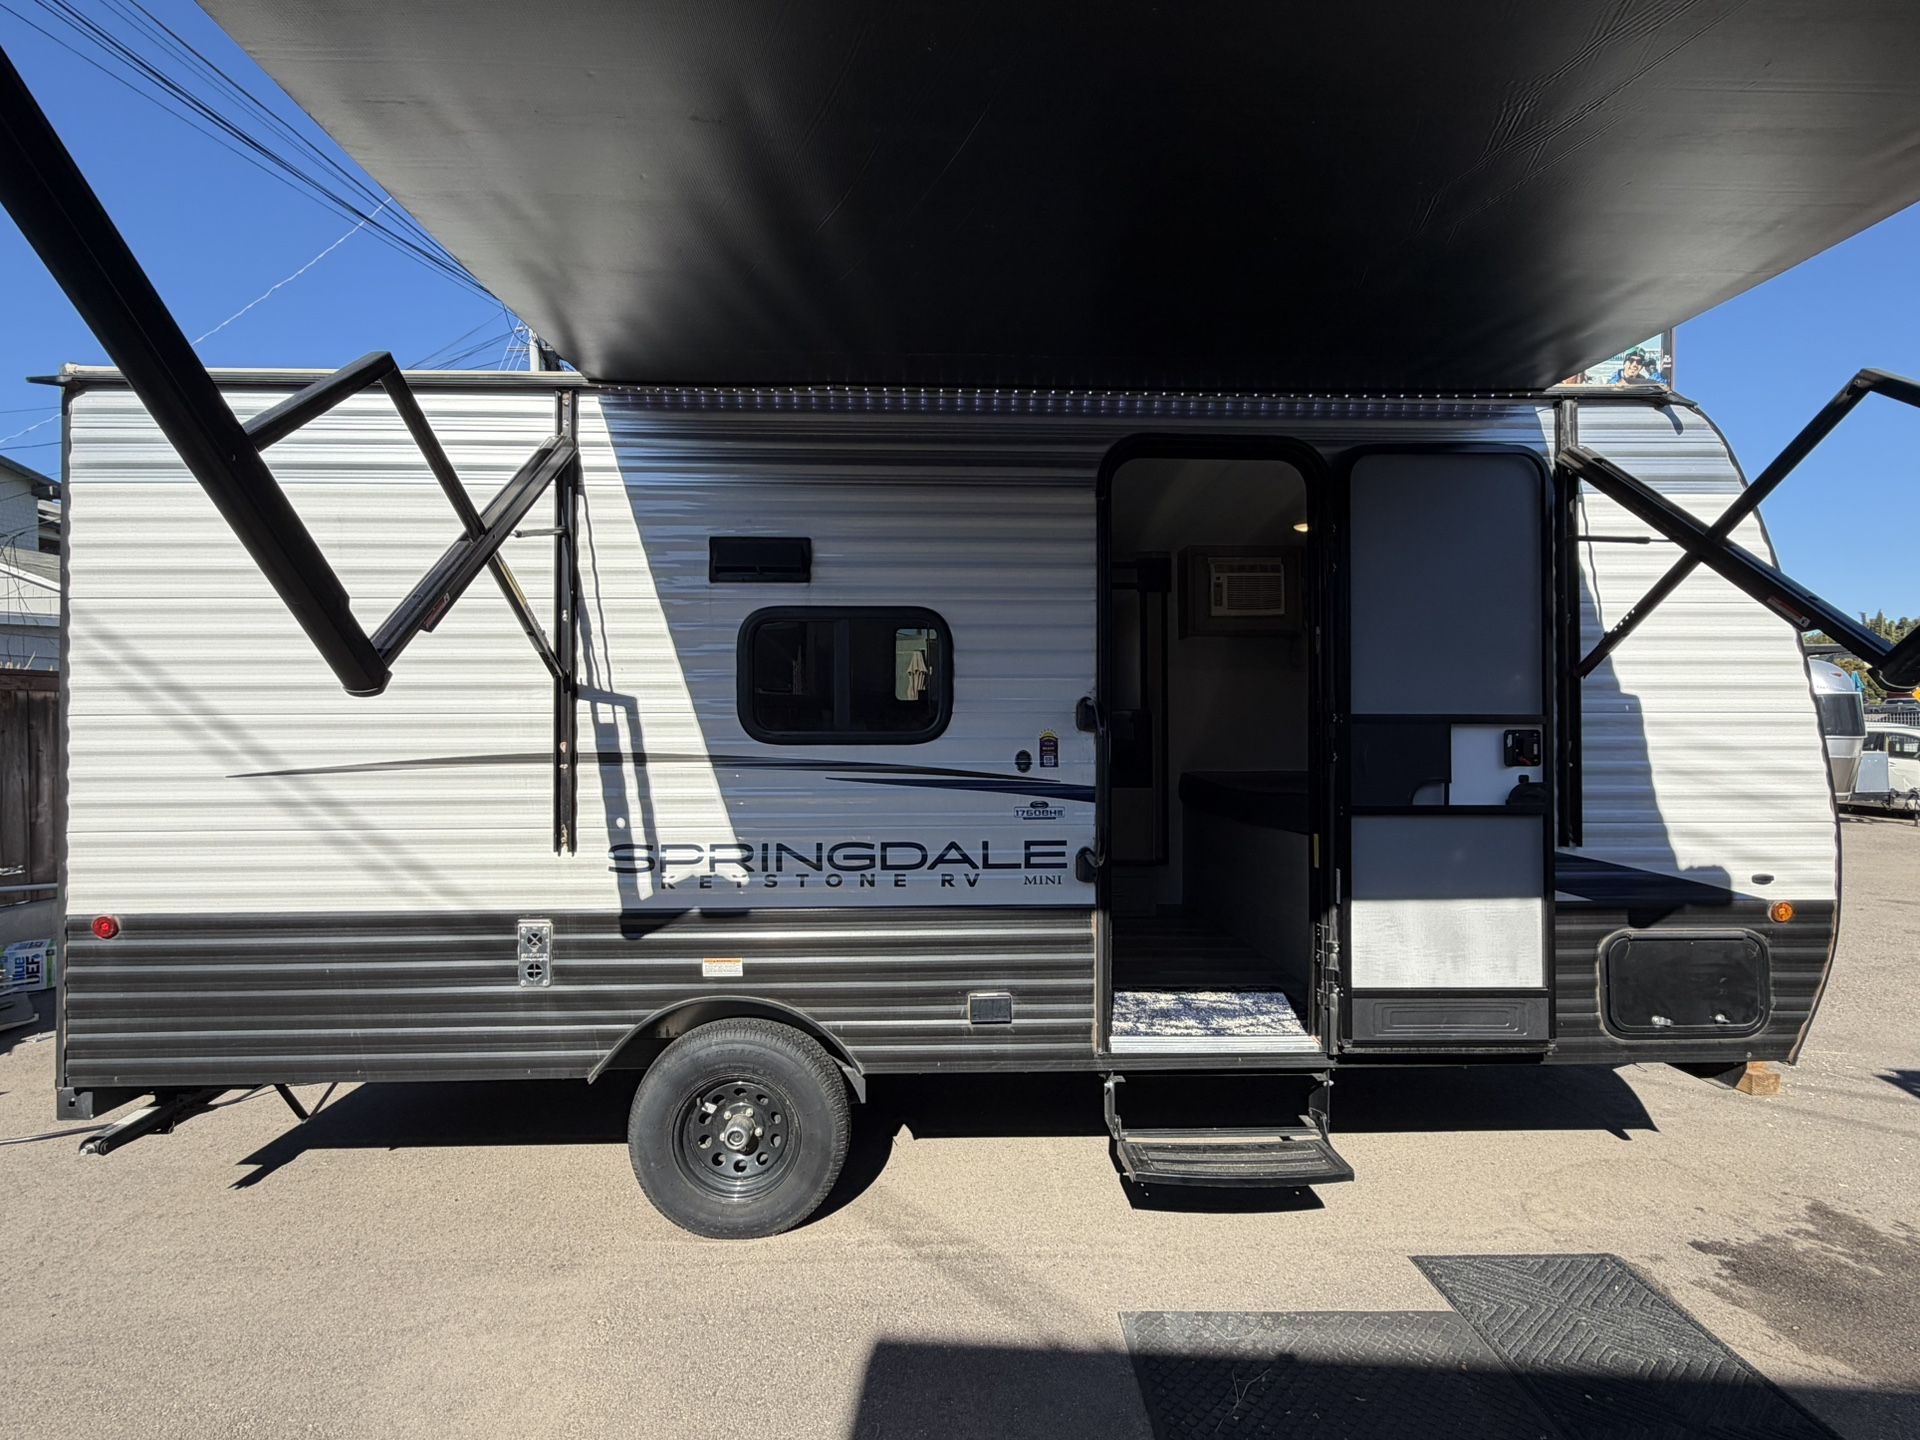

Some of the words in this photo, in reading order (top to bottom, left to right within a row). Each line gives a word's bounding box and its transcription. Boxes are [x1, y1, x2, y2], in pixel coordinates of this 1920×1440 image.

[608, 840, 1068, 873] SPRINGDALE
[660, 873, 907, 890] KEYSTONE
[940, 873, 981, 888] RV
[1024, 874, 1063, 886] MINI
